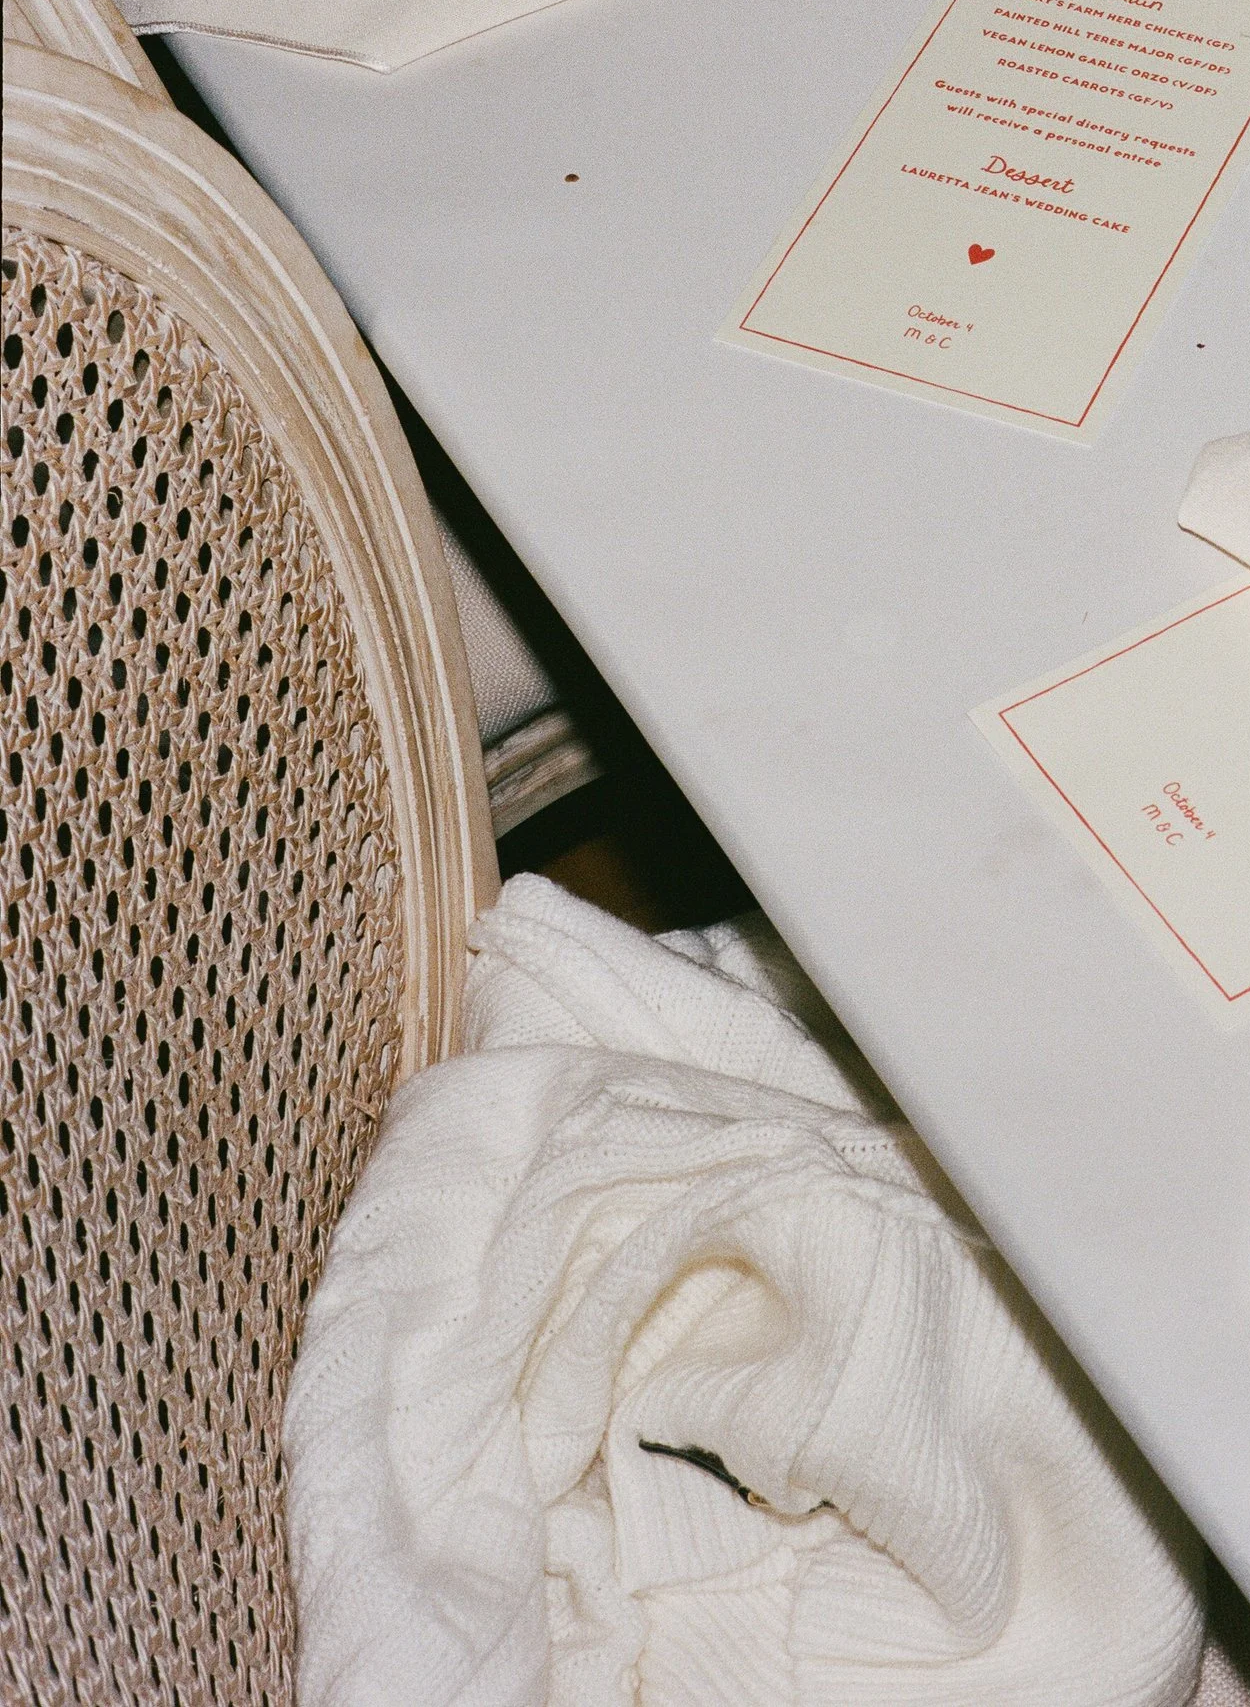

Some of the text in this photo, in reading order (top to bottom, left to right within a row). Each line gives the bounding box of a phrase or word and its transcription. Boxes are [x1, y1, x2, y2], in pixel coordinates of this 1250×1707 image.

[993, 8, 1232, 75] PAINTED HILL TERES MAJOR (GF/DF)
[1066, 1, 1105, 19] FARM
[1106, 13, 1142, 29] HERB
[1143, 22, 1204, 45] CHICKEN
[1206, 38, 1235, 50] (GF)
[982, 29, 1217, 95] VEGAN LEMON GARLIC ORZO (V/DF)
[997, 57, 1173, 109] ROASTED CARROTS (GF/V)
[933, 79, 1195, 157] Guests with special dietary requests
[946, 104, 1162, 167] will receive a personal entrée
[901, 165, 970, 189] LAURETTA
[1024, 198, 1088, 222] WEDDING
[1091, 216, 1130, 234] CAKE
[982, 155, 1074, 194] Dessert
[903, 327, 952, 349] M & C
[907, 304, 974, 332] October 4
[1141, 804, 1184, 846] M & C
[1163, 782, 1203, 830] October
